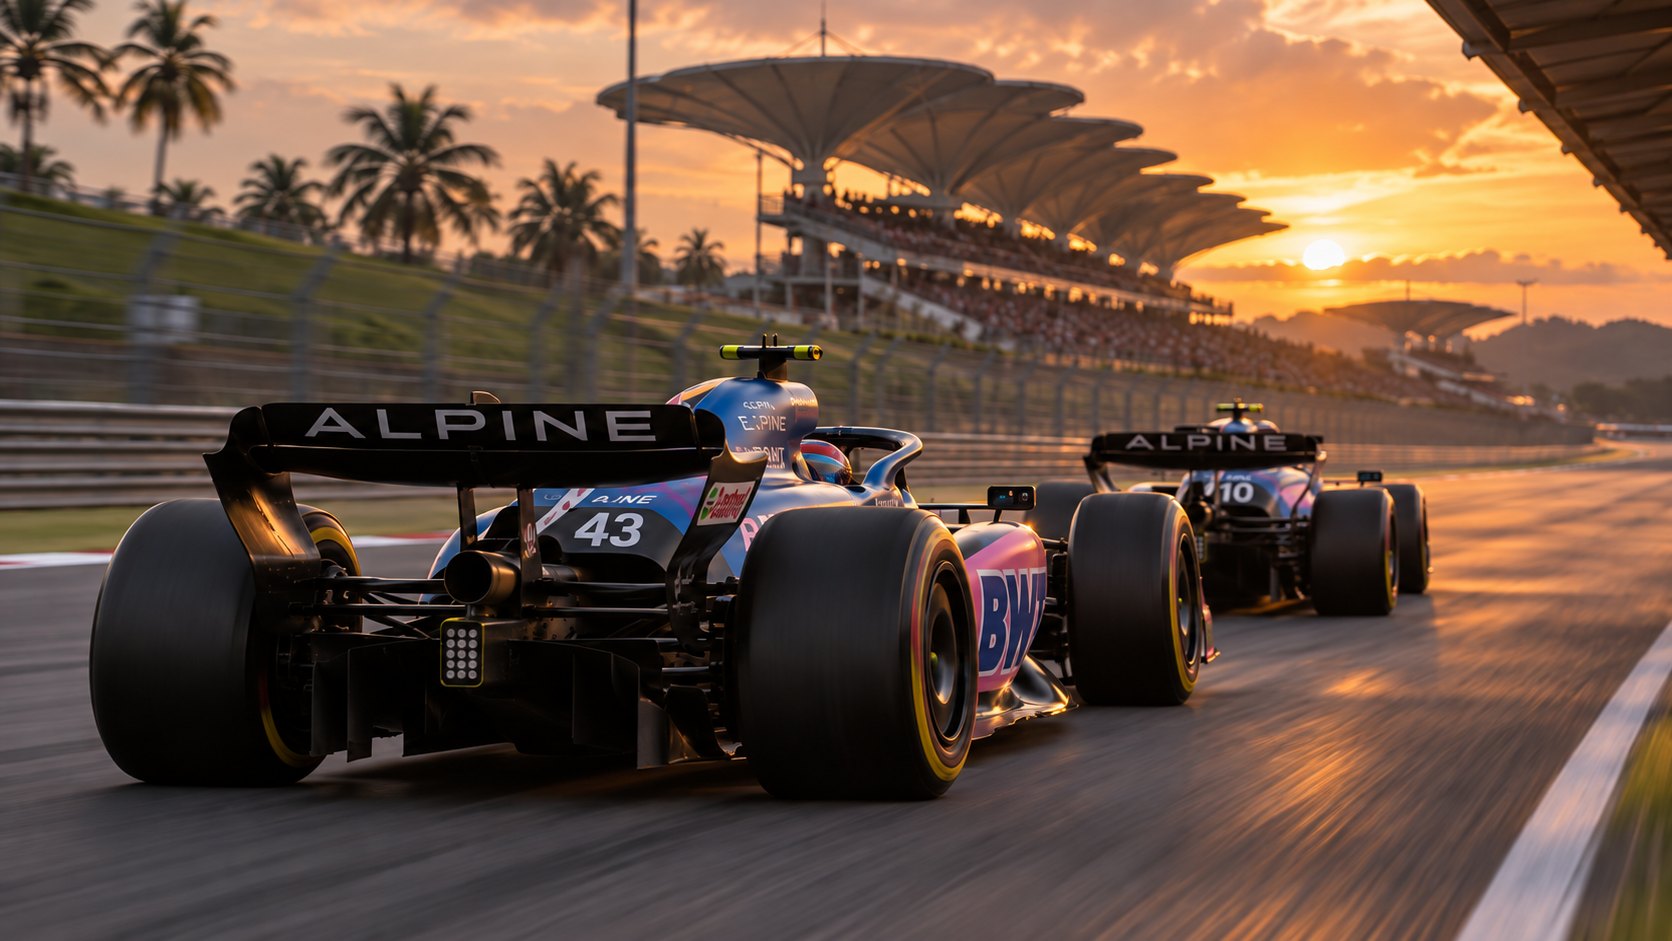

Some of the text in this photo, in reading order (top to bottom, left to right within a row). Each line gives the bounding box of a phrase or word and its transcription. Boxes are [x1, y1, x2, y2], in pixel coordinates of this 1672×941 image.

[304, 406, 657, 442] ALPINE
[1125, 433, 1288, 452] ALPINE
[1219, 482, 1254, 503] 10
[573, 511, 644, 548] 43
